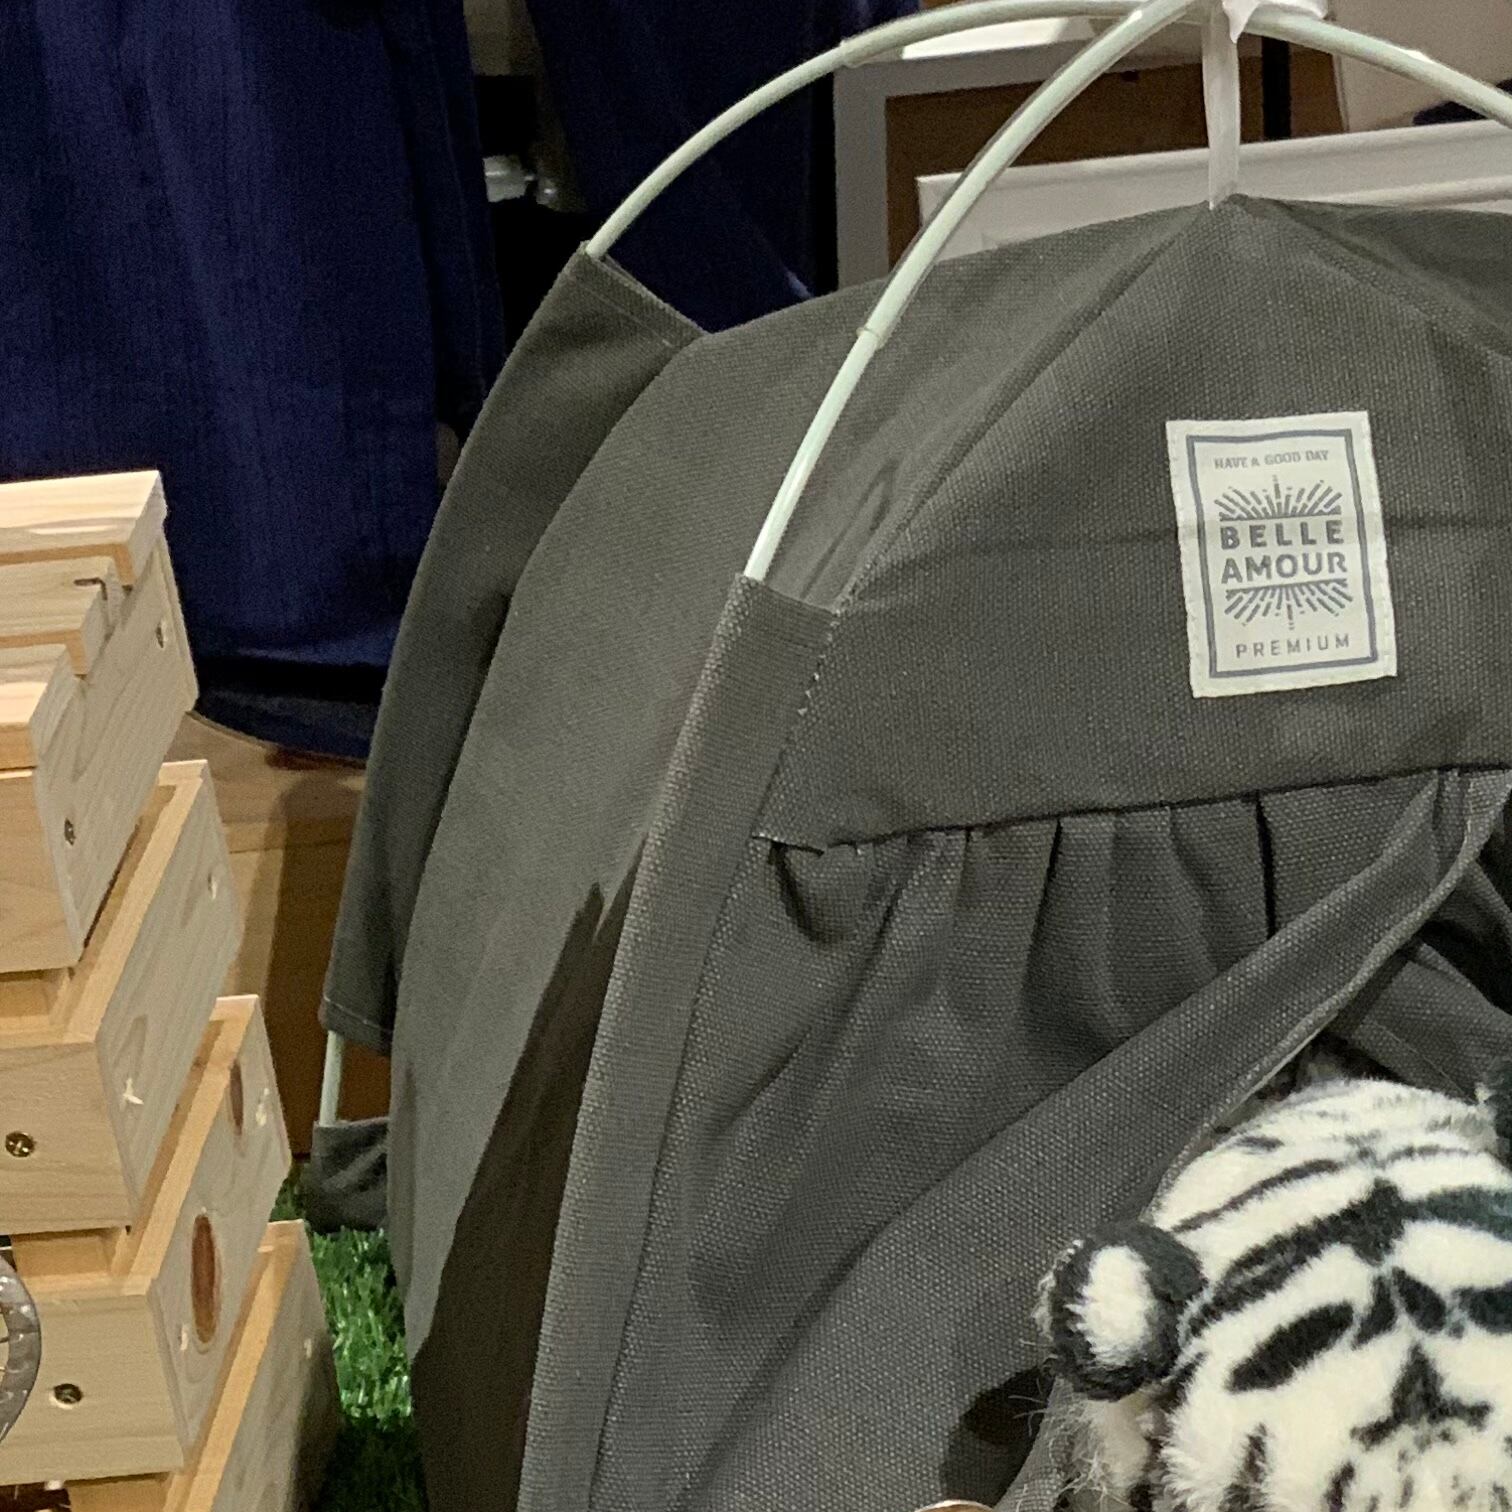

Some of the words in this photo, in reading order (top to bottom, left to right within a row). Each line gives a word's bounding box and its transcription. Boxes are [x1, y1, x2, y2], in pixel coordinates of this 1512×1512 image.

[1214, 457, 1248, 469] HAVE
[1251, 457, 1260, 467] A
[1264, 451, 1301, 466] GOOD
[1305, 450, 1328, 461] DAY
[1220, 520, 1344, 550] BELLE
[1221, 552, 1348, 584] AMOUR
[1236, 633, 1350, 658] PREMIUM
